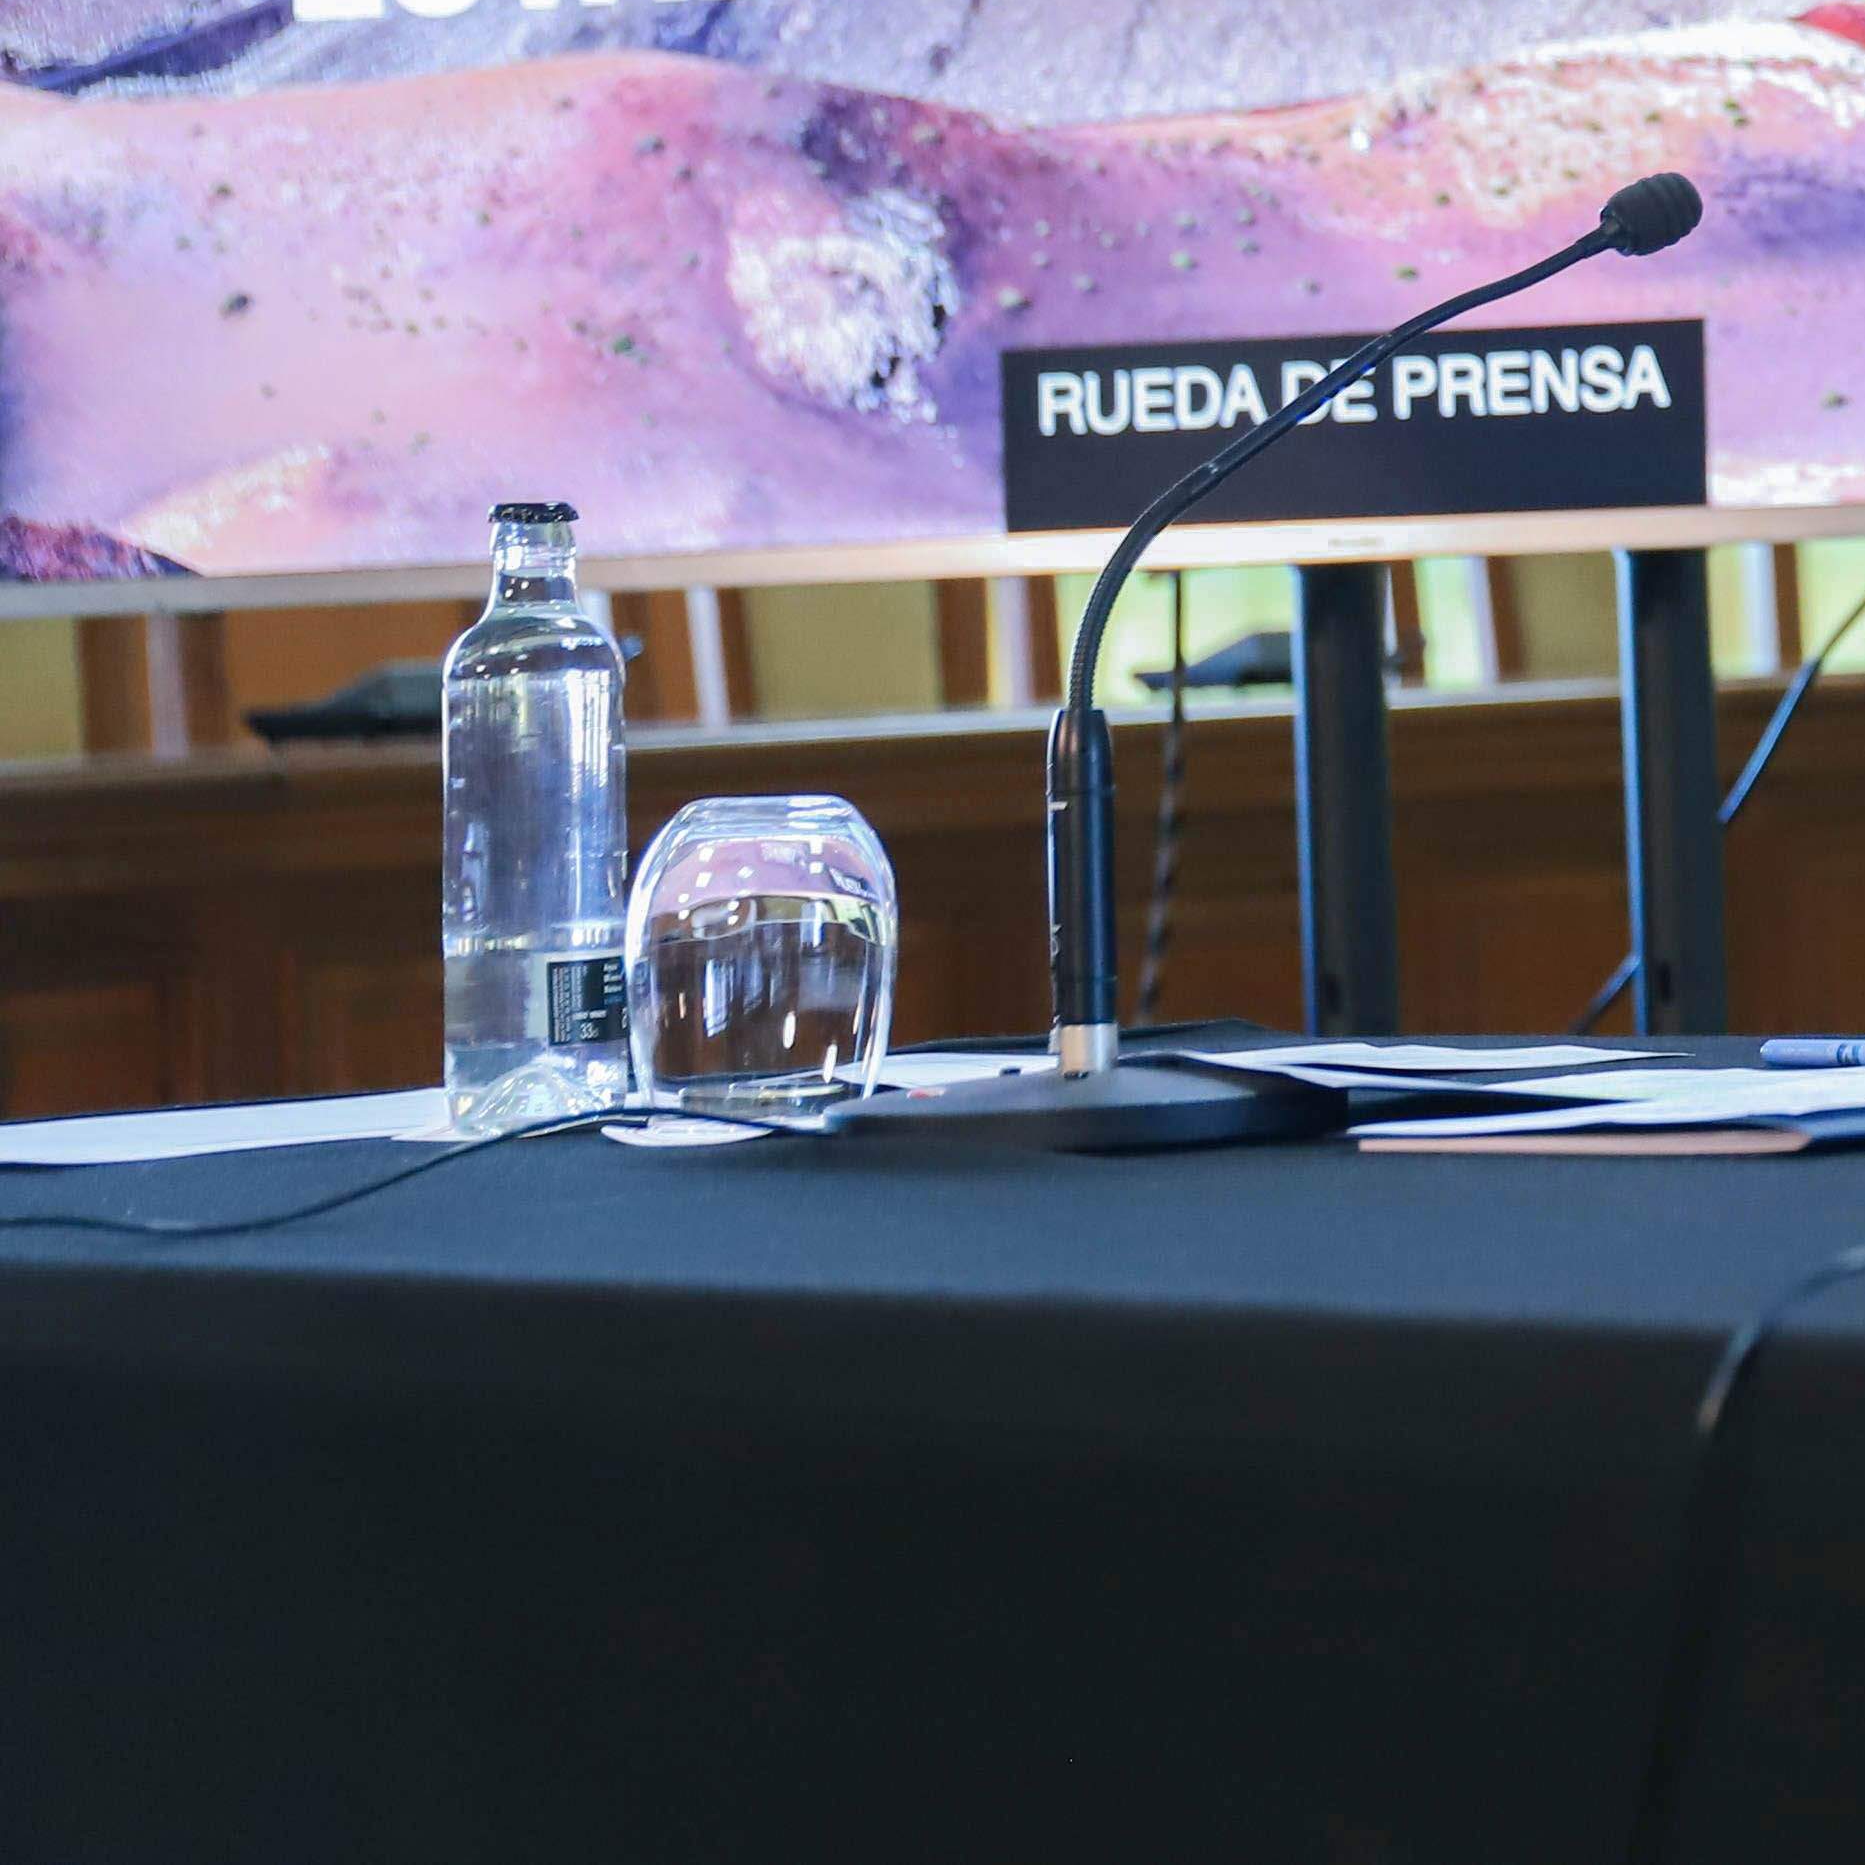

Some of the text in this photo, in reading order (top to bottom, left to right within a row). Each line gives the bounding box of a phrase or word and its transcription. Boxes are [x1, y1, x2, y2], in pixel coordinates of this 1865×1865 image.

[1036, 344, 1672, 437] RUEDA DE PRENSA
